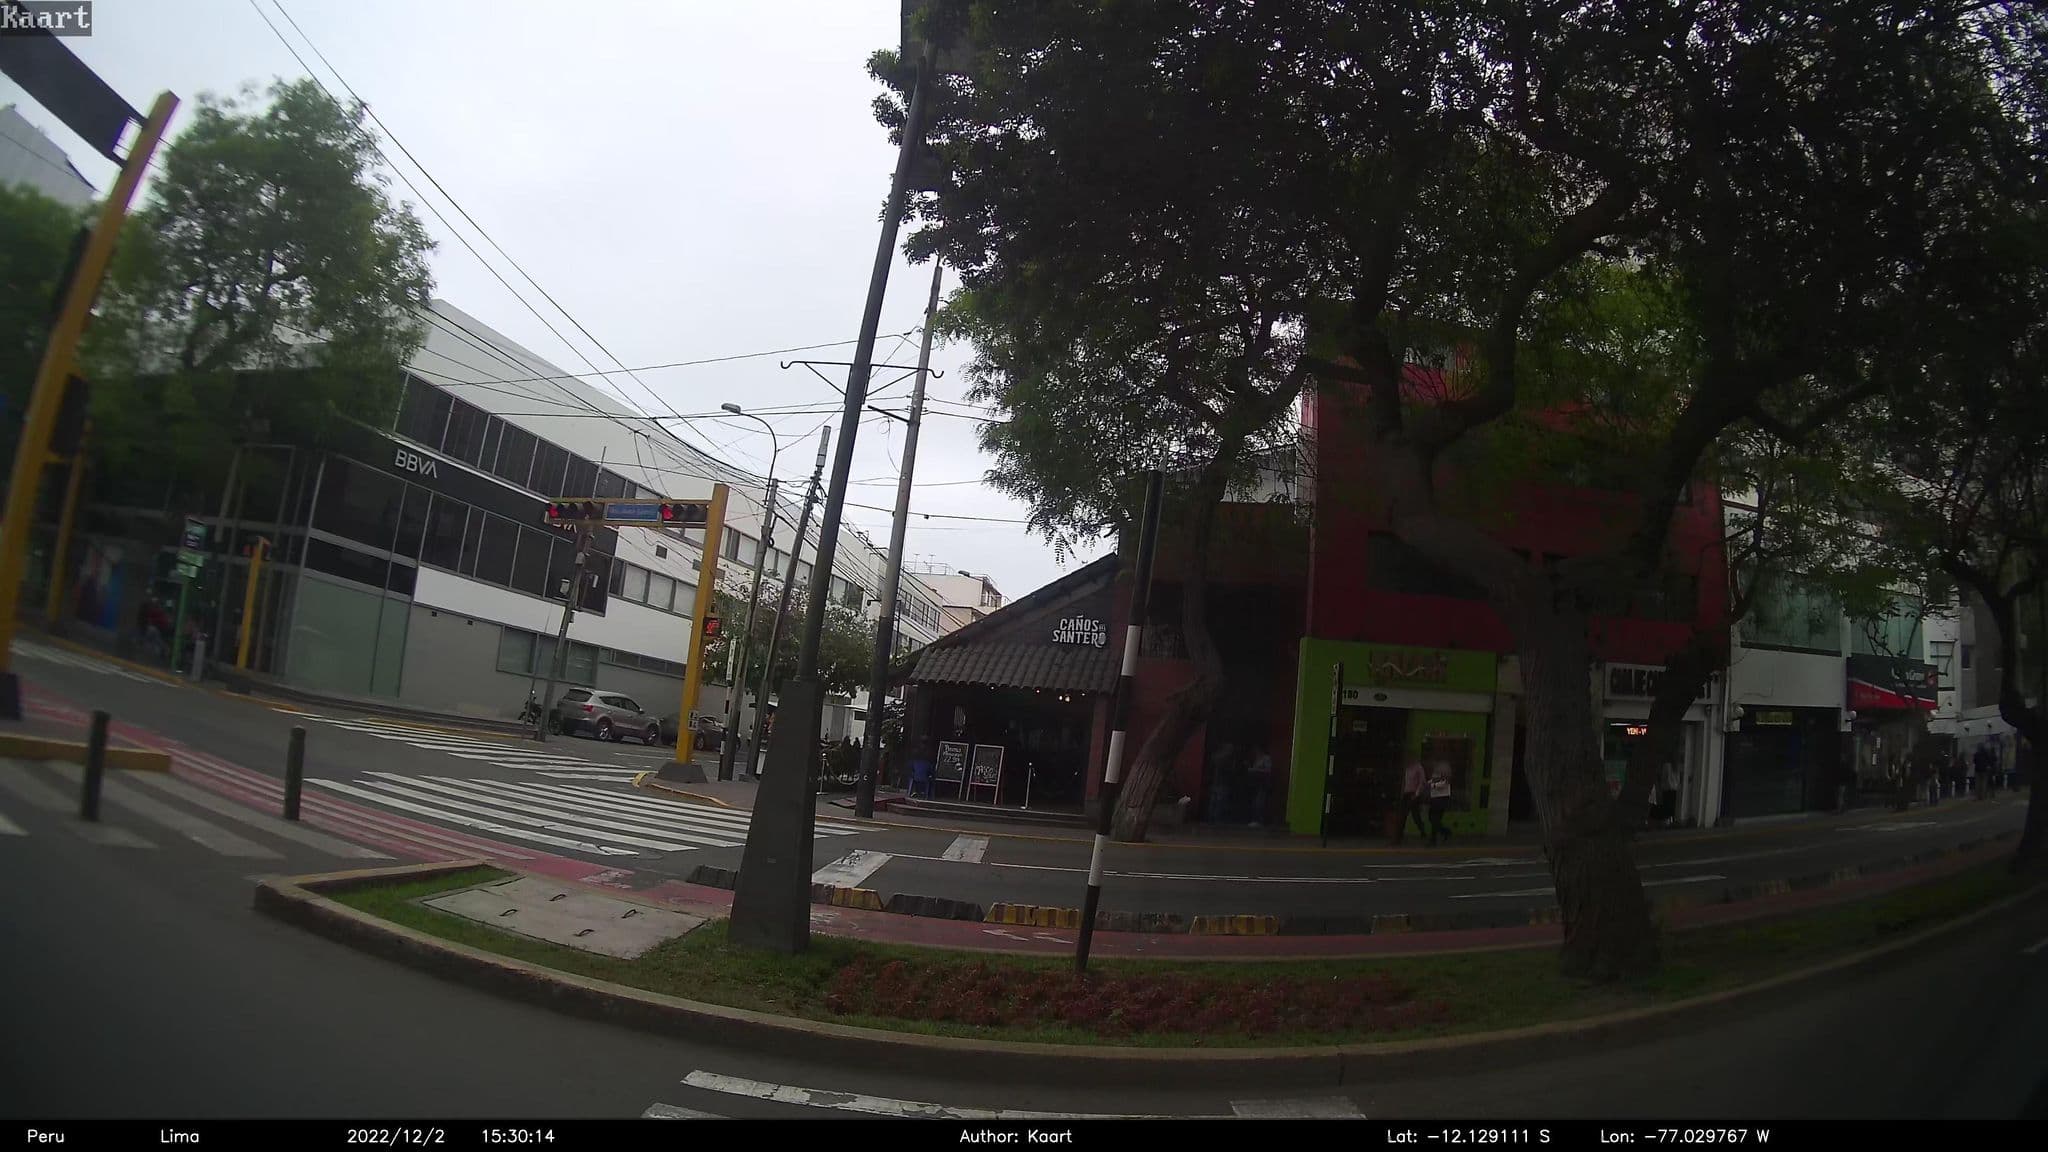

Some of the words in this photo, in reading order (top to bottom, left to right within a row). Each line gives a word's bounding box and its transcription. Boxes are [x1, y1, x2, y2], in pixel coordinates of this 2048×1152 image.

[395, 449, 437, 478] BBVA
[1059, 614, 1100, 632] CAÑOS
[1052, 629, 1107, 649] SANTERO
